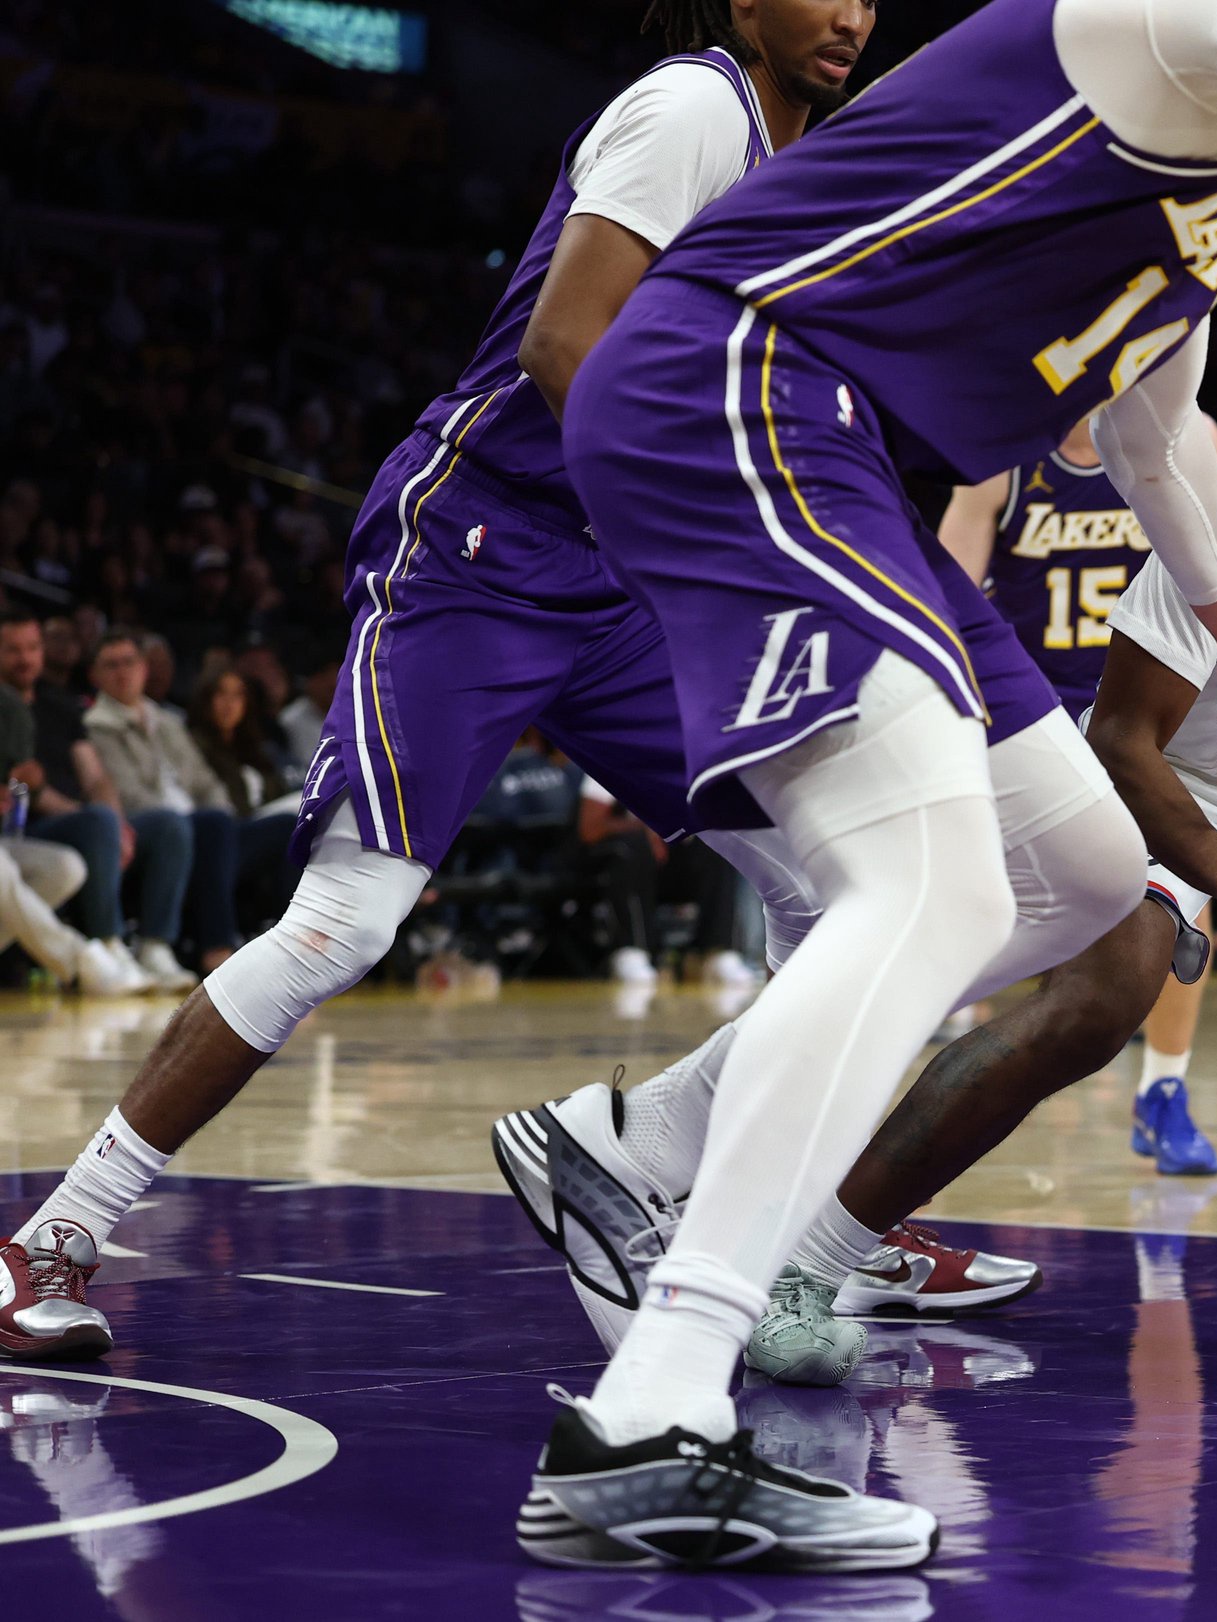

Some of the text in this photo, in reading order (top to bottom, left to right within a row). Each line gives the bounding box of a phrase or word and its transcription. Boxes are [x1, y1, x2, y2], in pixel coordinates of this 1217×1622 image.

[1011, 502, 1153, 559] LAKER
[1043, 566, 1127, 649] 15
[720, 606, 835, 733] LA
